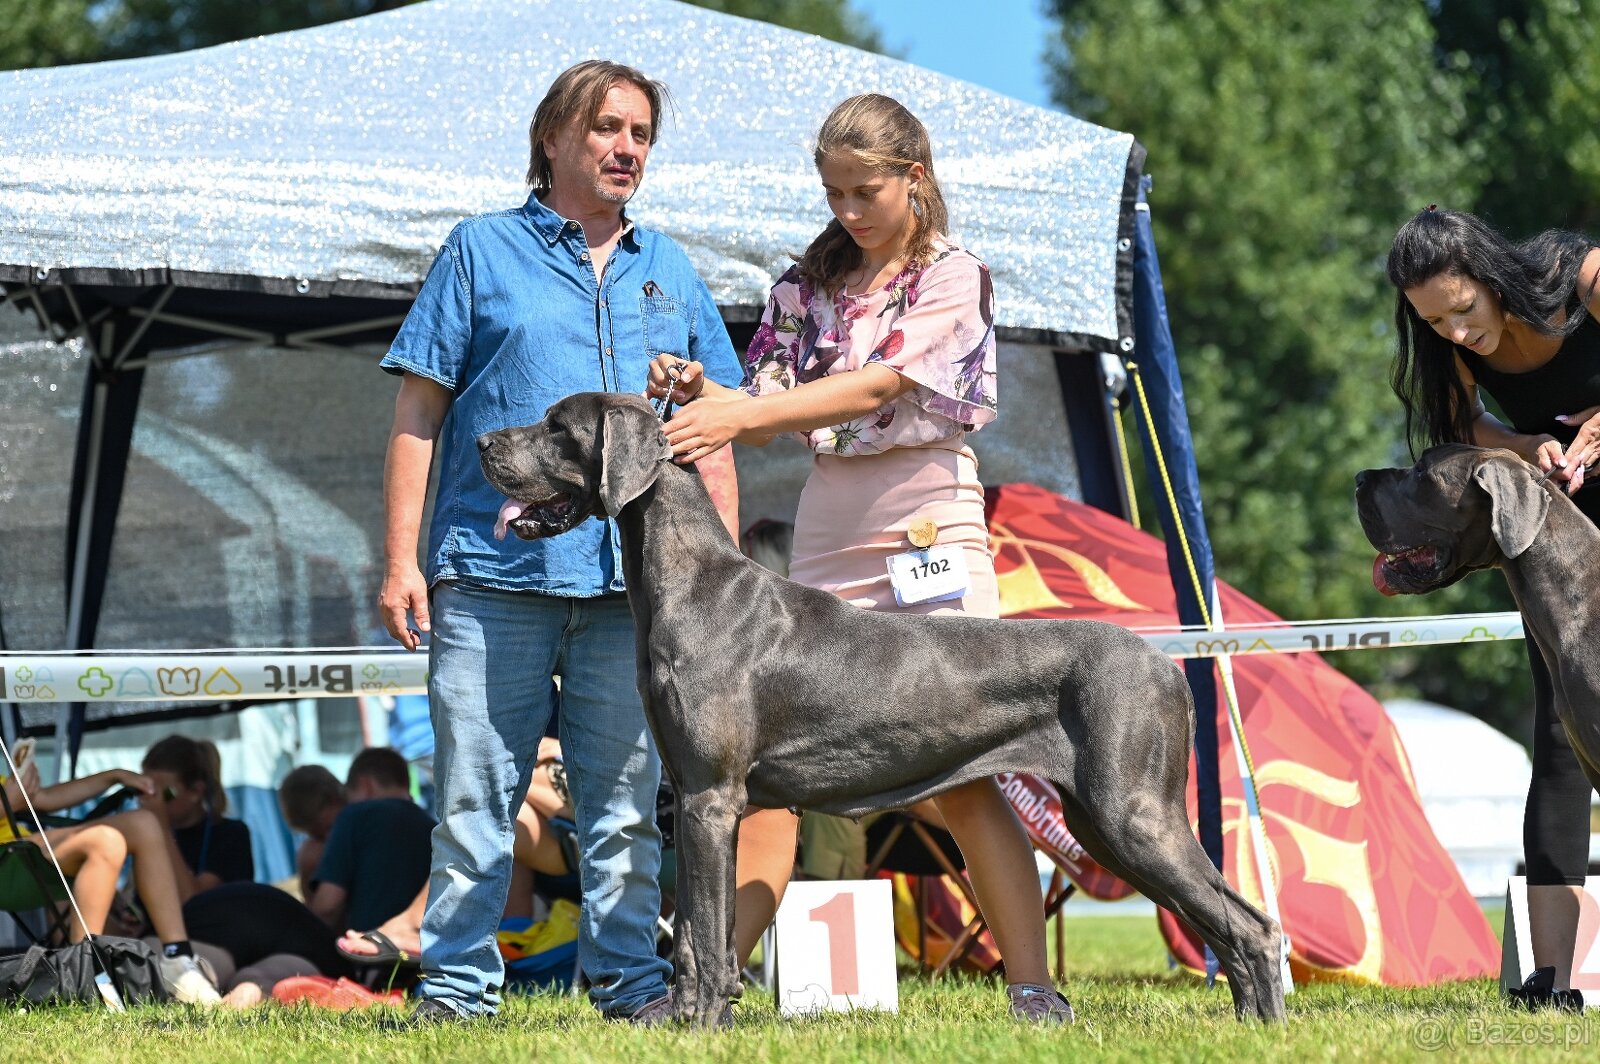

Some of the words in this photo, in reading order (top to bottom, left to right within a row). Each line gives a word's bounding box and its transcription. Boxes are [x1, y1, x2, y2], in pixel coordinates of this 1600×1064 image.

[910, 557, 951, 580] 1702
[264, 664, 353, 694] Brit
[809, 892, 859, 995] 1
